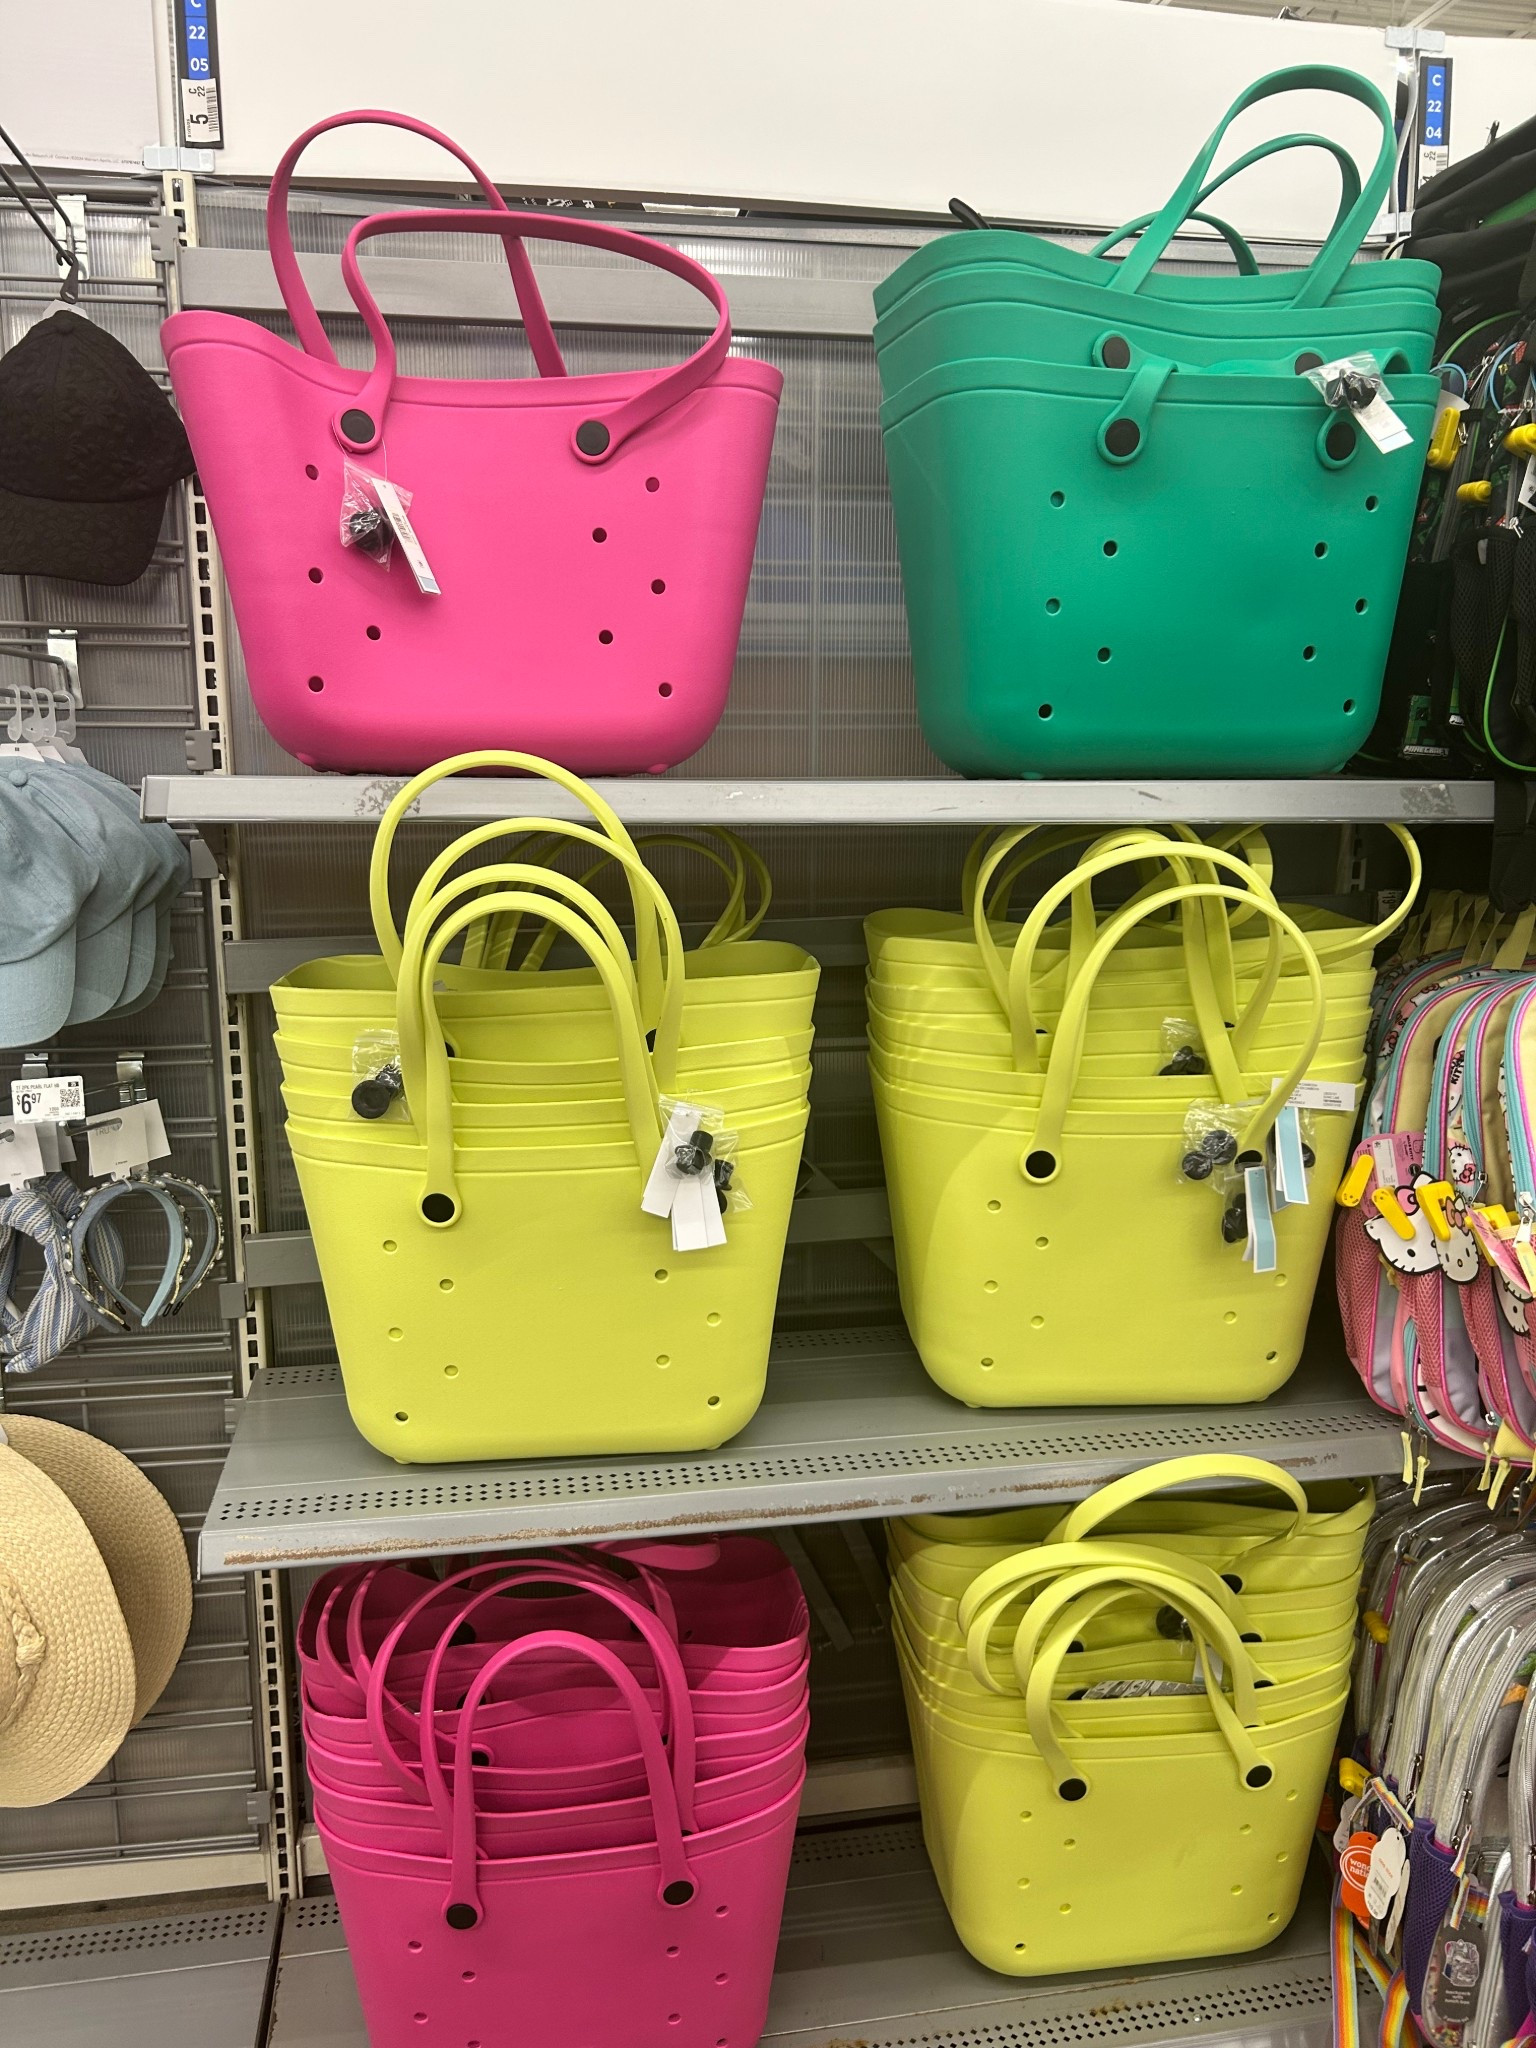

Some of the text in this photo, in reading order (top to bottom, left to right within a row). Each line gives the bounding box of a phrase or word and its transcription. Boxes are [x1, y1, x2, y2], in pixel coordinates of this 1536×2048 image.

[188, 25, 206, 40] 22
[190, 57, 209, 72] 05
[1432, 74, 1442, 87] C
[197, 85, 206, 98] 22
[1427, 100, 1442, 113] 22
[189, 113, 209, 125] 5
[1425, 126, 1442, 139] 04
